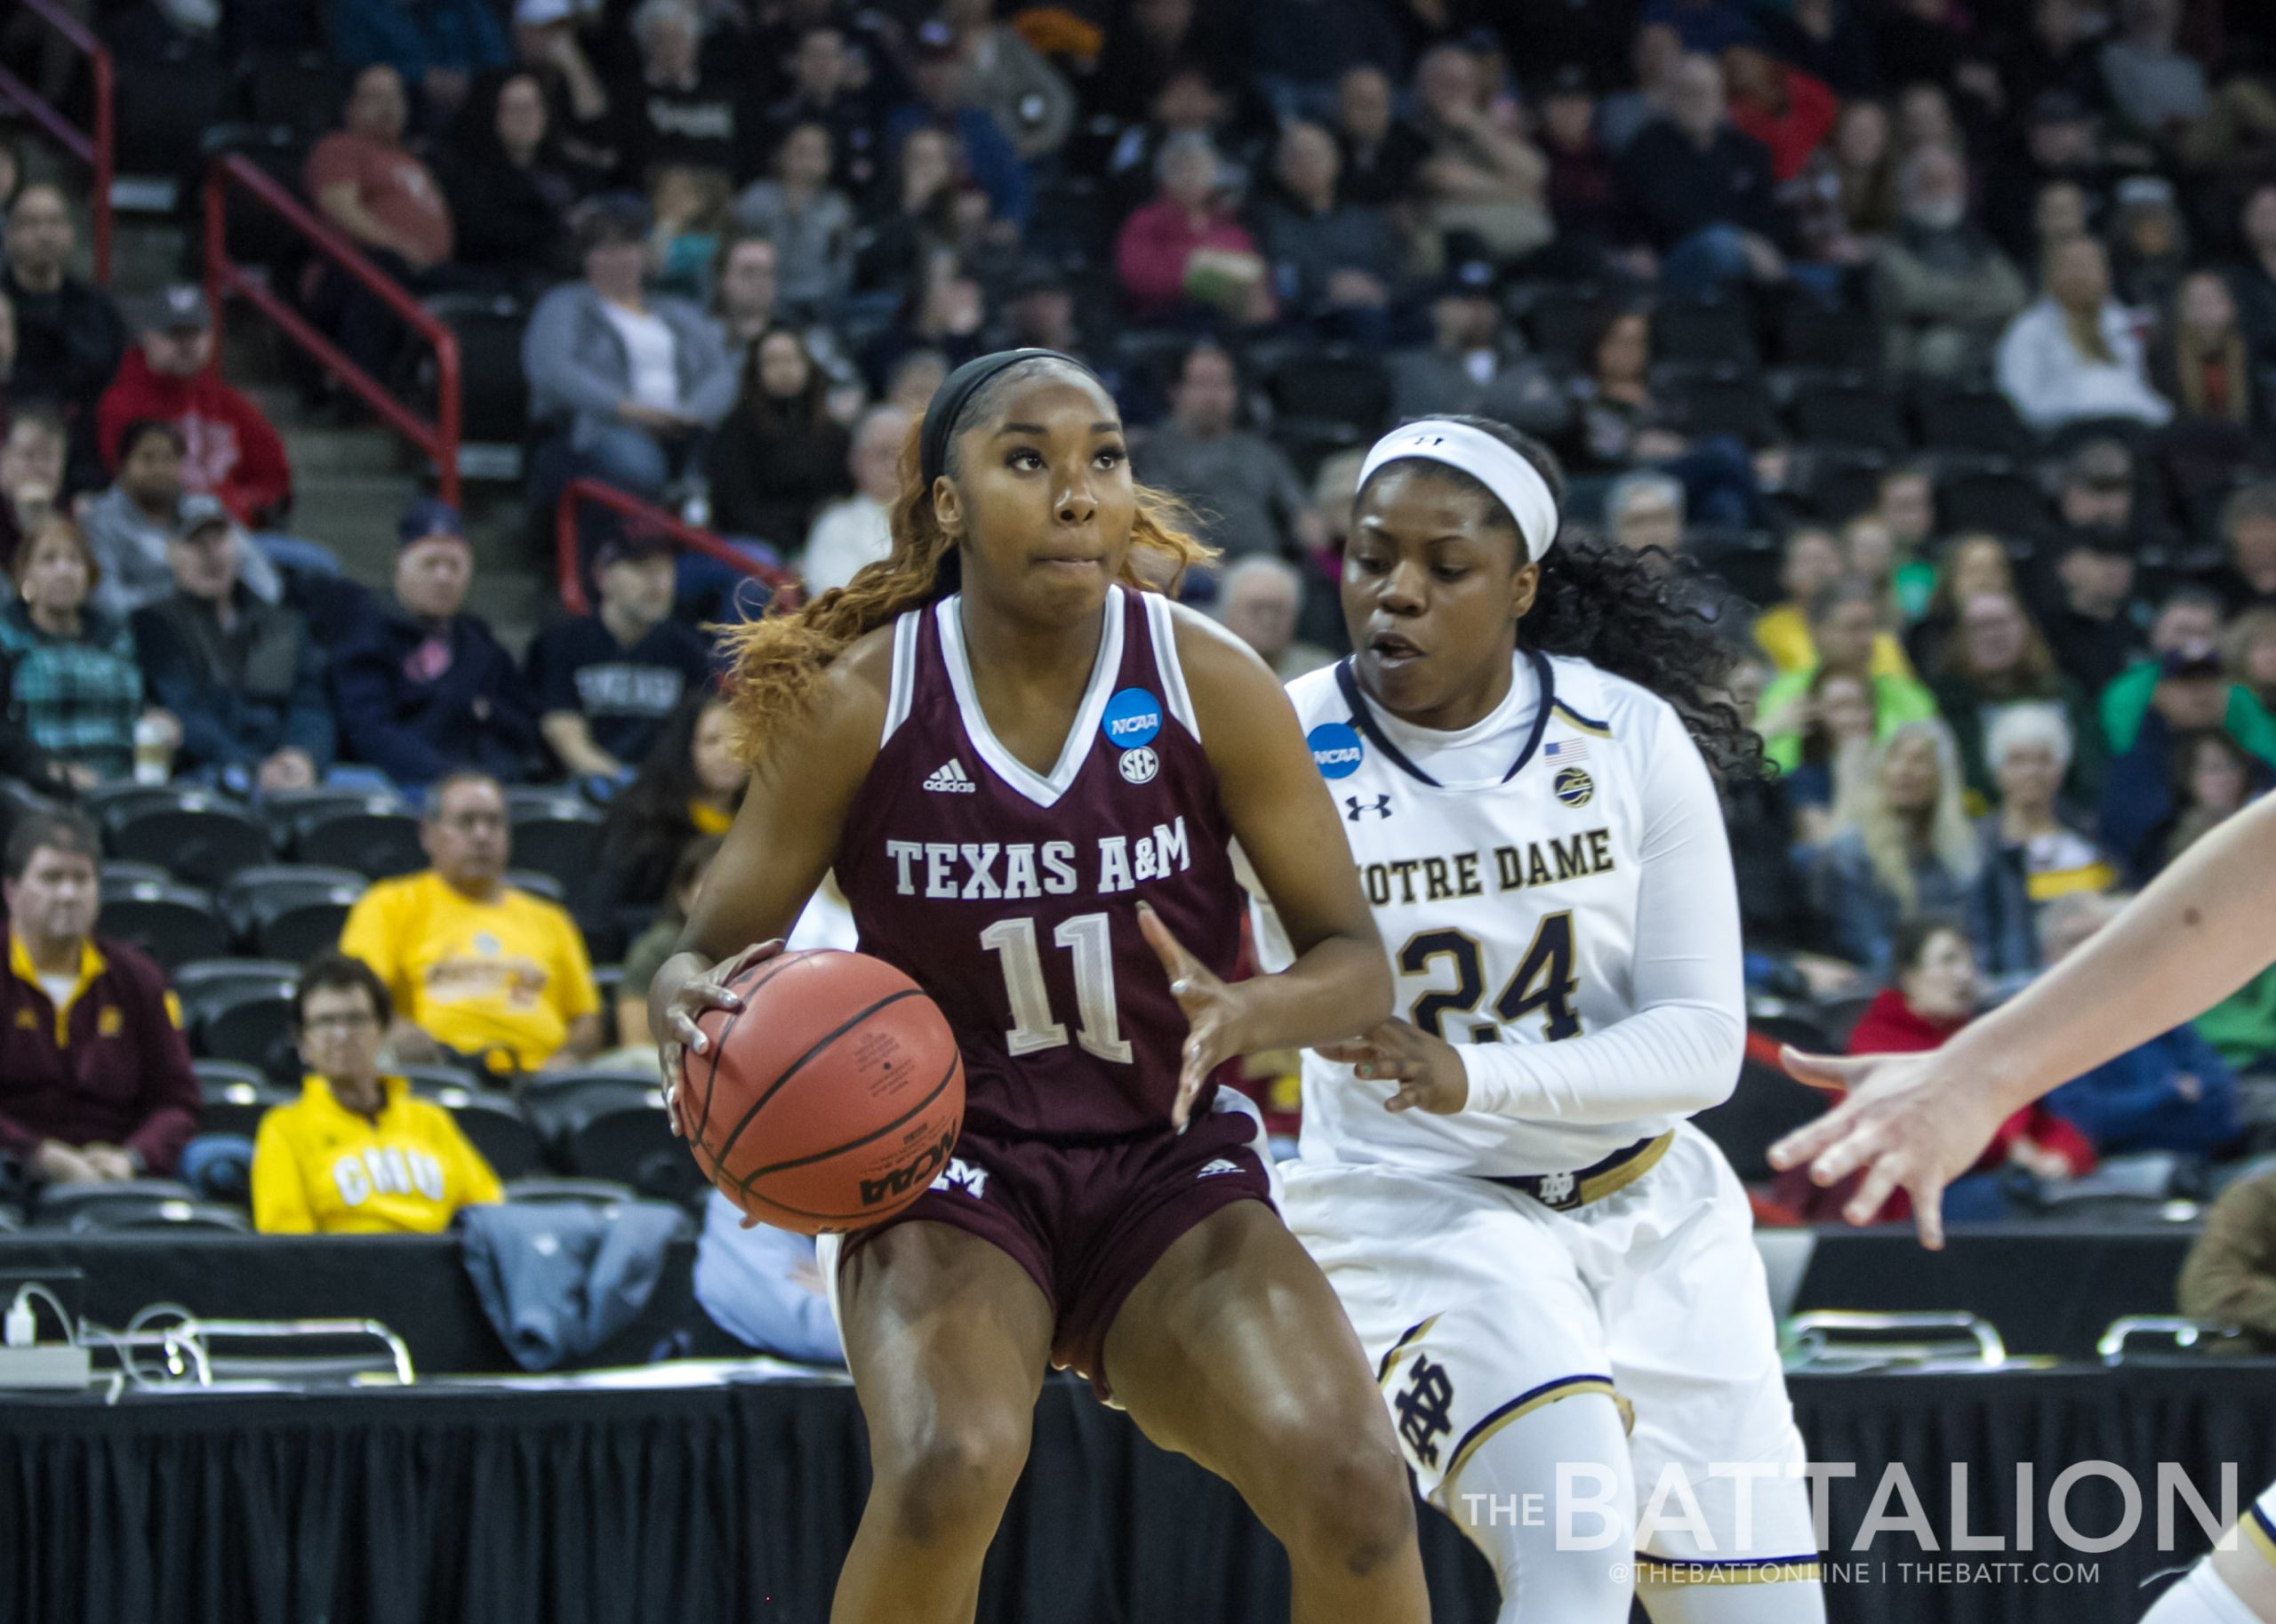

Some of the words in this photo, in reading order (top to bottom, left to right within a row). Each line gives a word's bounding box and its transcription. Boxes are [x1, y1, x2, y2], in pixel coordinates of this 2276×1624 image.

[1111, 713, 1158, 735] NCAA
[1313, 747, 1360, 764] NCAA
[923, 780, 976, 793] adidas
[1120, 748, 1158, 781] SEC
[886, 839, 1078, 900] TEXAS
[1097, 815, 1190, 893] A&M
[1357, 850, 1484, 907] OTRE
[1494, 828, 1615, 893] DAME
[980, 912, 1134, 1064] 11
[1396, 909, 1583, 1044] 24
[860, 1116, 958, 1206] NCAA
